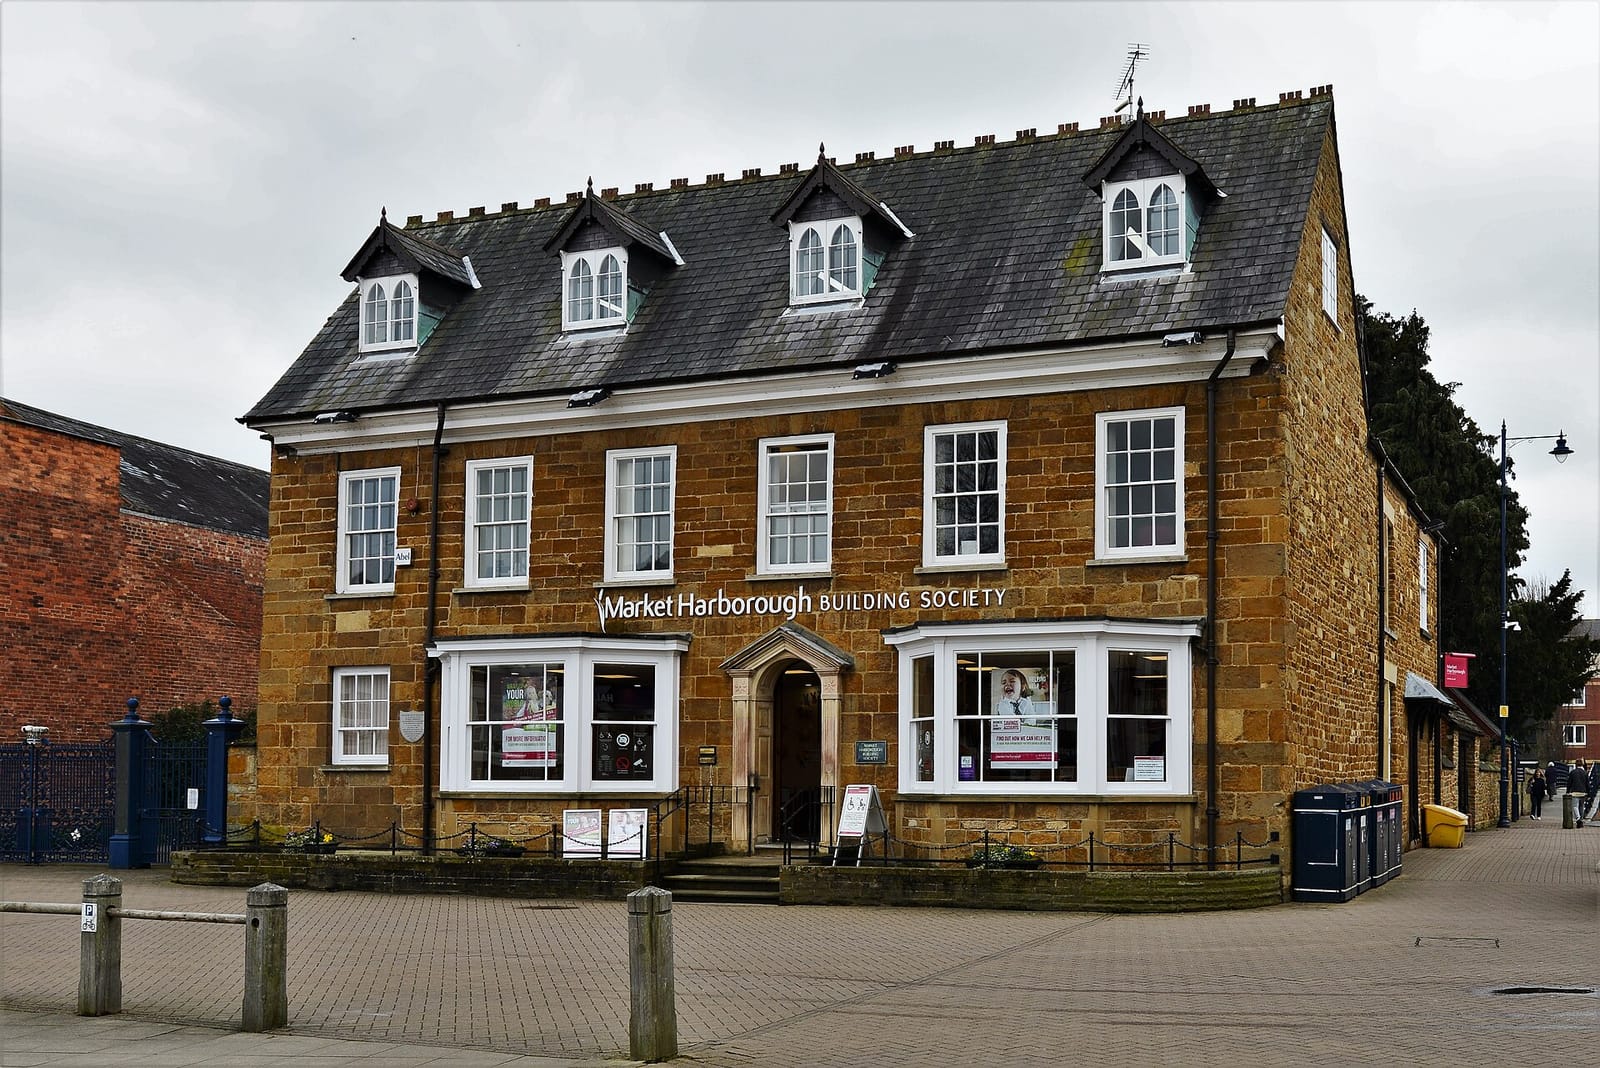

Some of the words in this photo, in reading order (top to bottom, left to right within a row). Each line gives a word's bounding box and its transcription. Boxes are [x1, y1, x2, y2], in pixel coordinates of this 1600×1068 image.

[604, 592, 674, 619] Market
[677, 585, 812, 621] Harborough
[819, 592, 910, 612] BUILDING
[920, 588, 1007, 609] SOCIETY
[506, 689, 524, 699] YOUR
